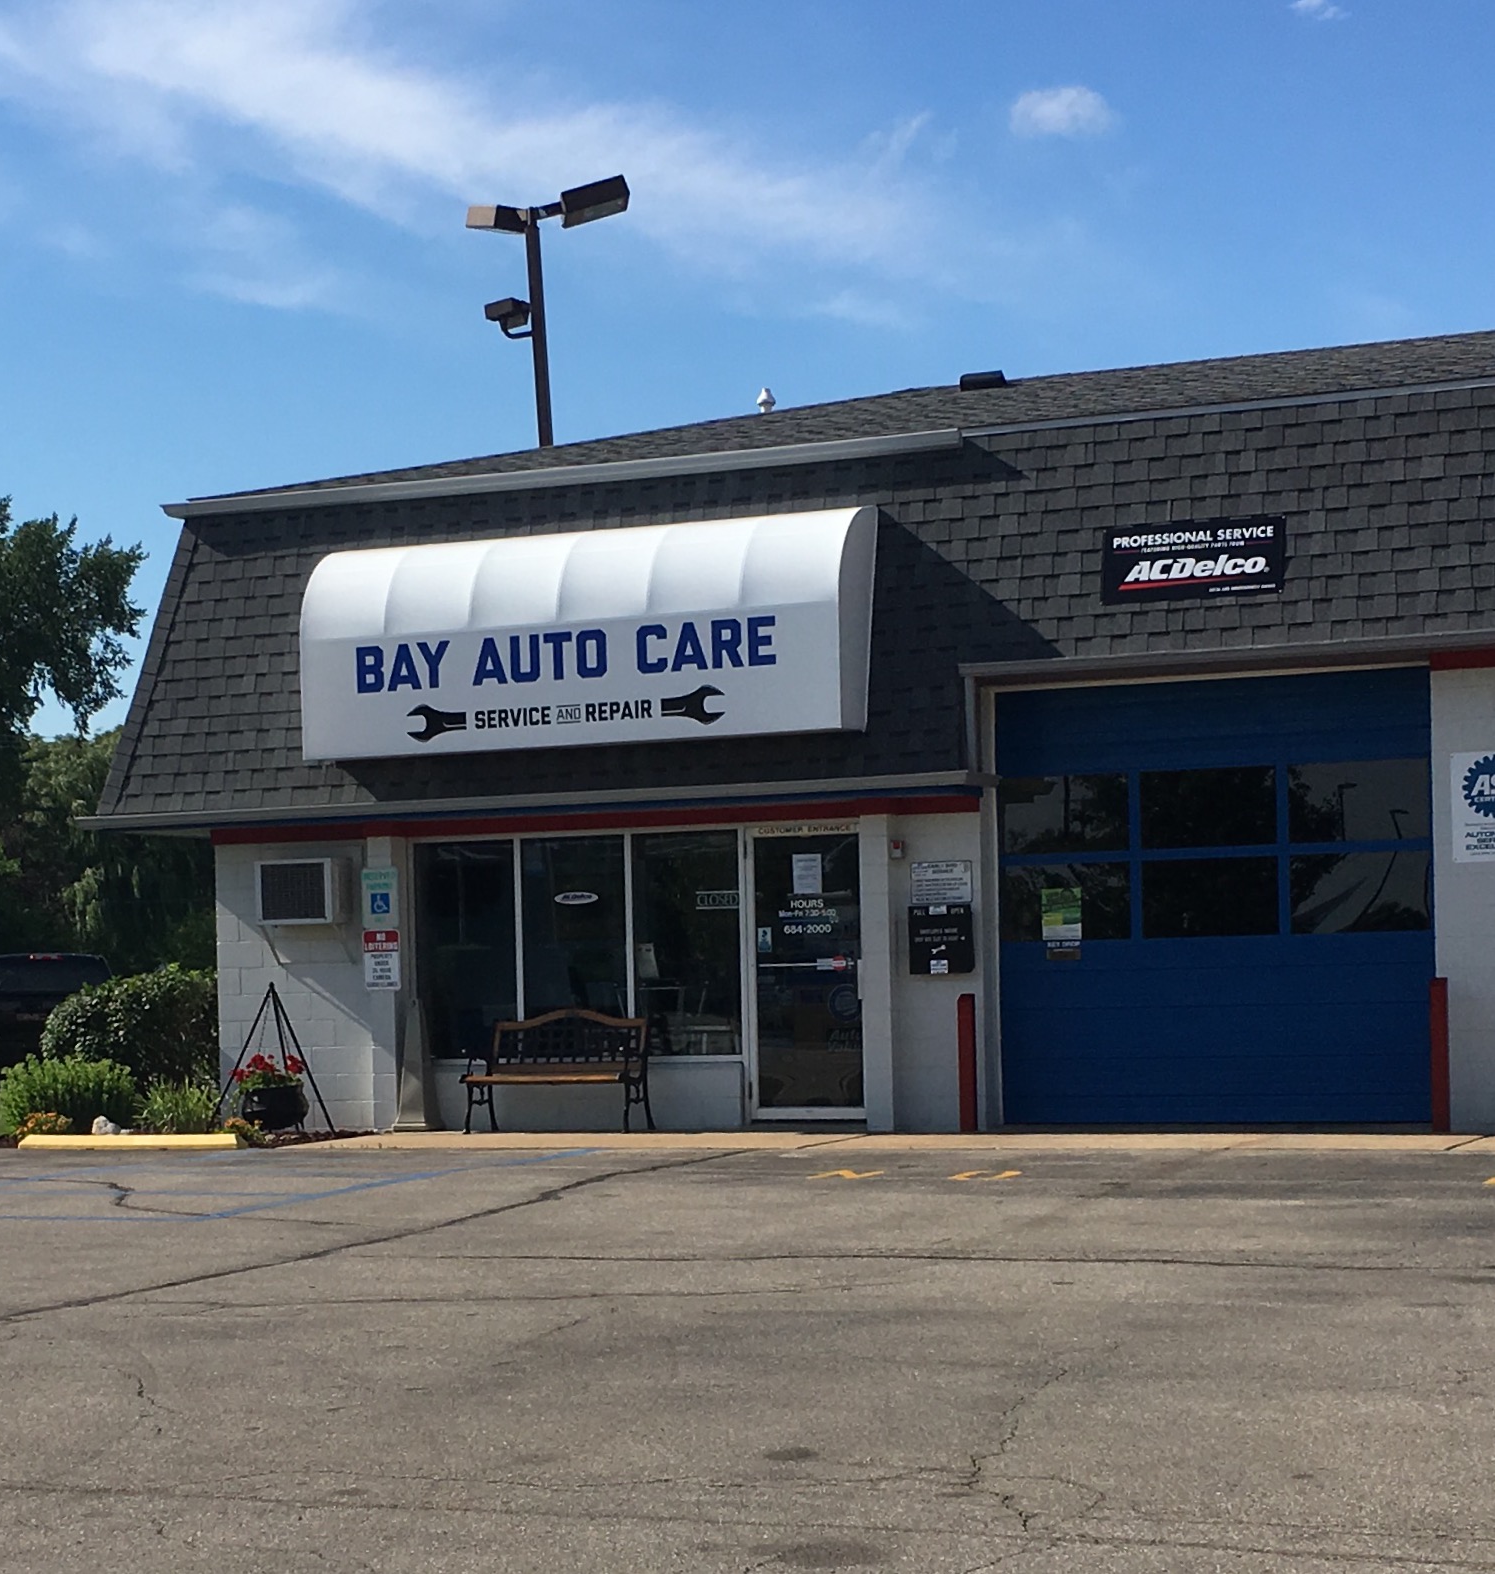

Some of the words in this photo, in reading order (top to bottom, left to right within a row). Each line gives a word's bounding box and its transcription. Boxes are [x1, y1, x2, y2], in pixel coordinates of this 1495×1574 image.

[1113, 530, 1213, 549] PROFESSIONAL
[1217, 526, 1274, 540] SERVICE
[1124, 554, 1268, 582] ACDelco
[355, 640, 450, 694] BAY
[472, 629, 608, 687] AUTO
[636, 615, 777, 675] CARE
[474, 706, 552, 730] SERVICE
[557, 705, 581, 723] AND
[585, 700, 652, 723] REPAIR
[758, 826, 803, 836] CUSTOMER
[807, 823, 851, 833] ENTRANCE
[697, 894, 738, 906] CLOSED
[790, 899, 824, 909] HOURS
[376, 933, 386, 941] NO
[365, 942, 398, 951] LOITERING
